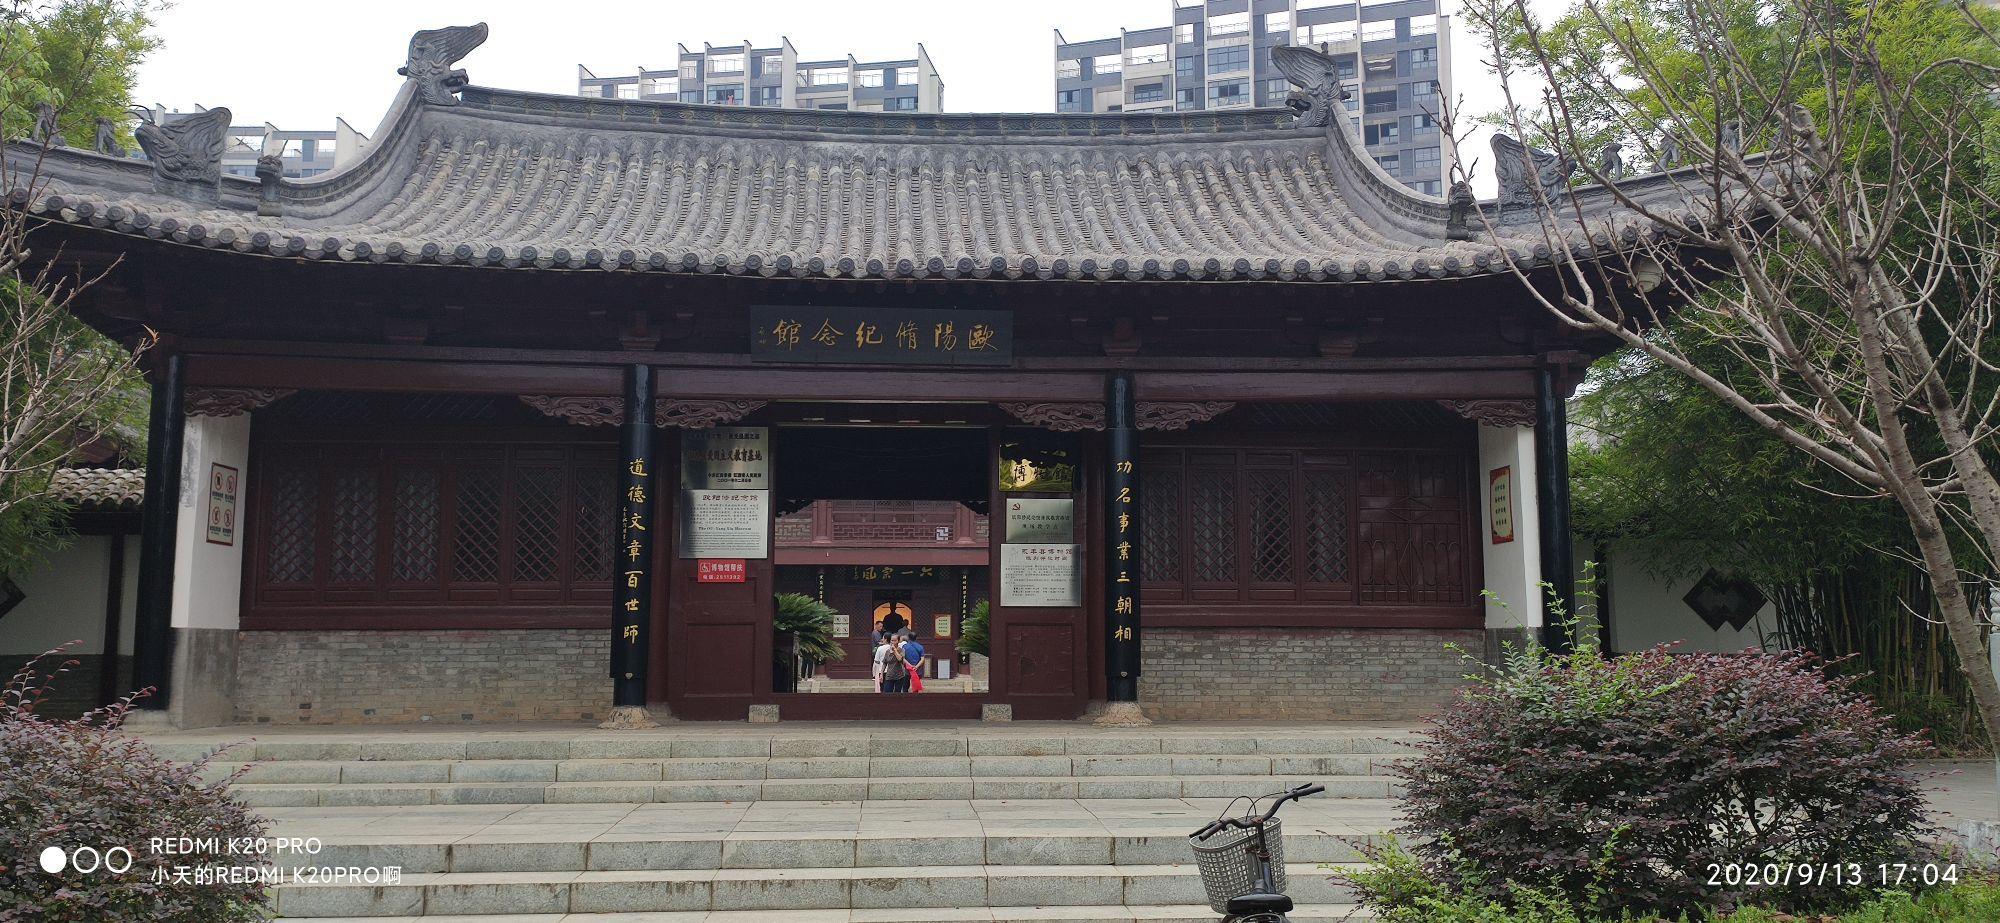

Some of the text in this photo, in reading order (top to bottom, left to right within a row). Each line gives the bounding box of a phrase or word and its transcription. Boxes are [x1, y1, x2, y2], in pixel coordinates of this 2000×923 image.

[623, 458, 648, 644] 道德文章百世師
[1114, 460, 1133, 642] 功名事業三朝相
